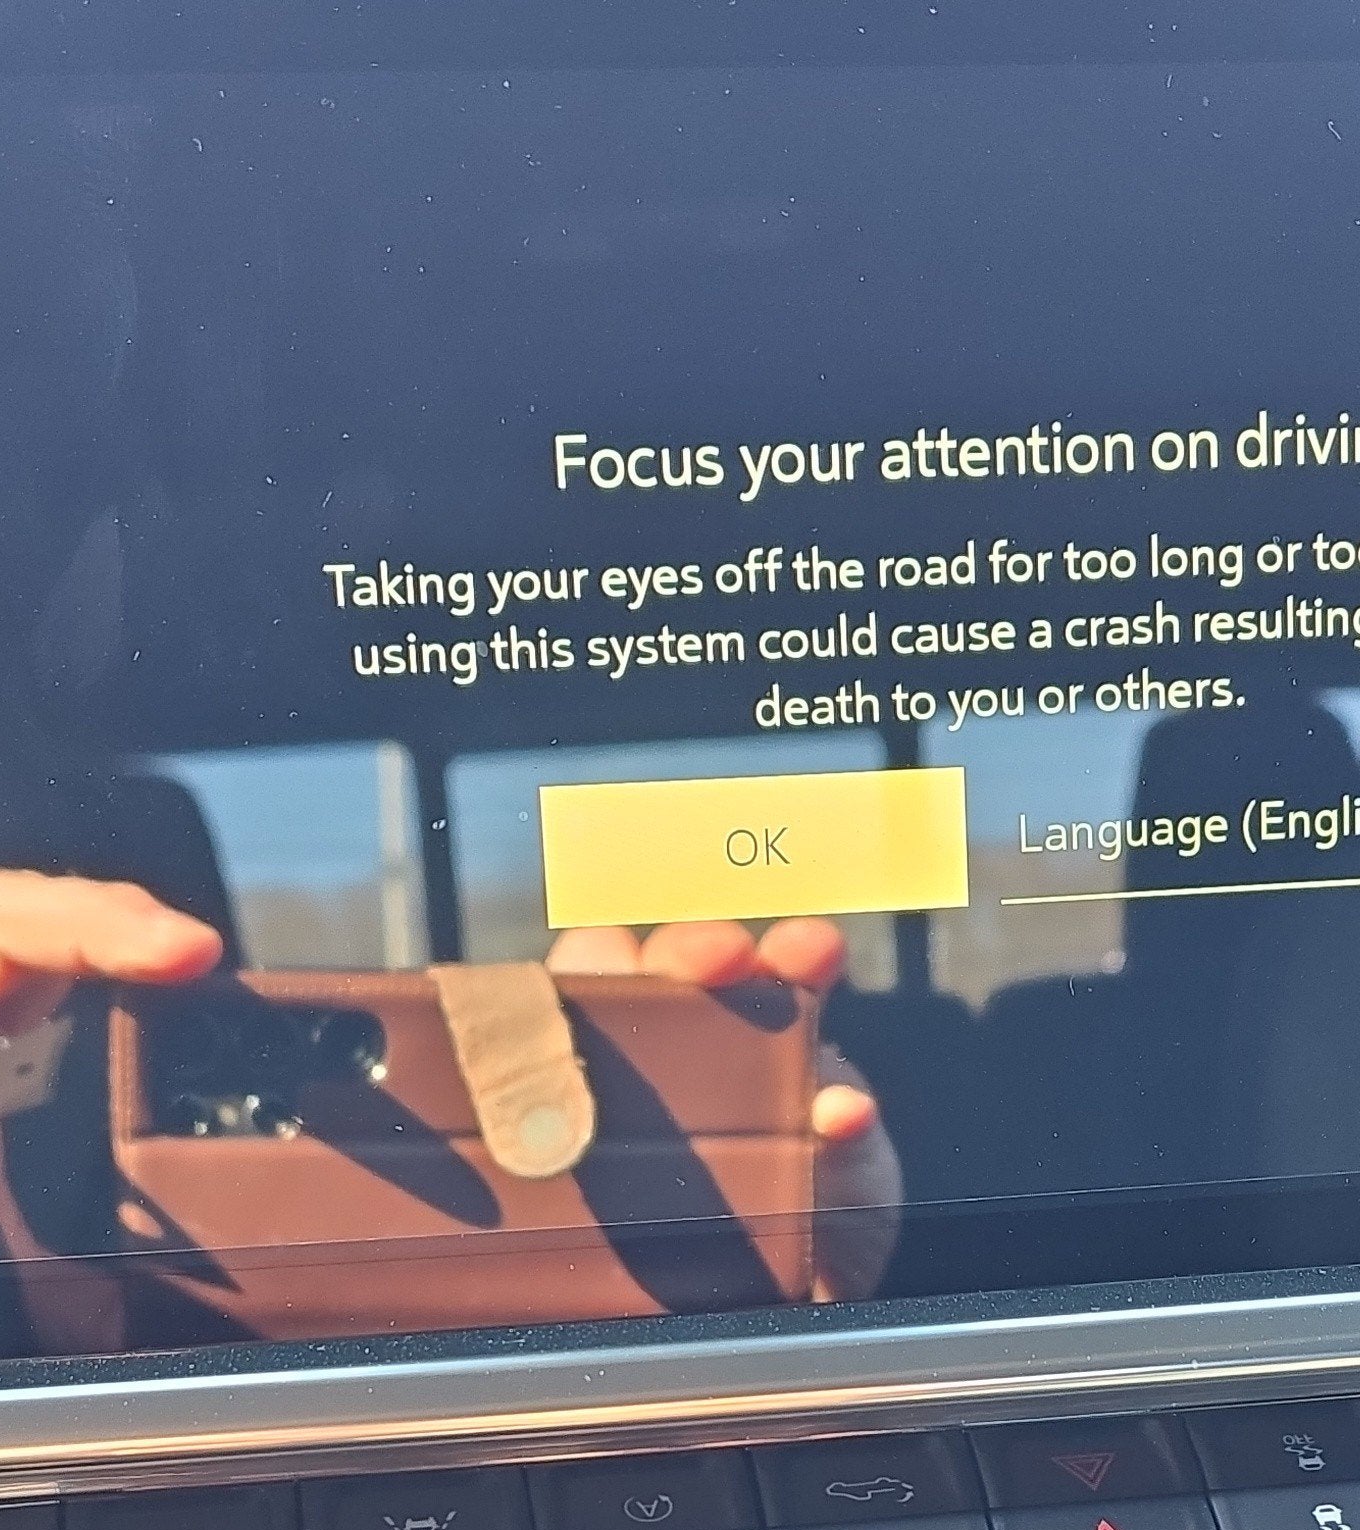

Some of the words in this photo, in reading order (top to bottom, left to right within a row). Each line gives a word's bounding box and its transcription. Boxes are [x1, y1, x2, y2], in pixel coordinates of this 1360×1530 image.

[552, 434, 726, 489] Focus
[738, 442, 866, 502] your
[880, 421, 1136, 480] attention
[1150, 430, 1220, 471] on
[322, 560, 476, 616] Taking
[486, 568, 589, 615] your
[600, 564, 703, 610] eyes
[714, 546, 784, 595] off
[790, 545, 865, 590] the
[878, 540, 976, 588] road
[987, 539, 1053, 584] for
[1062, 542, 1137, 580] too
[1150, 533, 1243, 588] long
[1255, 542, 1303, 573] or
[353, 632, 478, 685] using
[488, 625, 575, 670] this
[586, 625, 745, 679] system
[758, 611, 877, 660] could
[890, 621, 1016, 655] cause
[1027, 619, 1052, 649] a
[1064, 600, 1180, 647] crash
[754, 679, 880, 727] death
[890, 683, 937, 721] to
[946, 687, 1024, 732] you
[1037, 684, 1085, 715] or
[1094, 667, 1246, 712] others.
[724, 826, 790, 868] OK
[1019, 814, 1228, 861] Language
